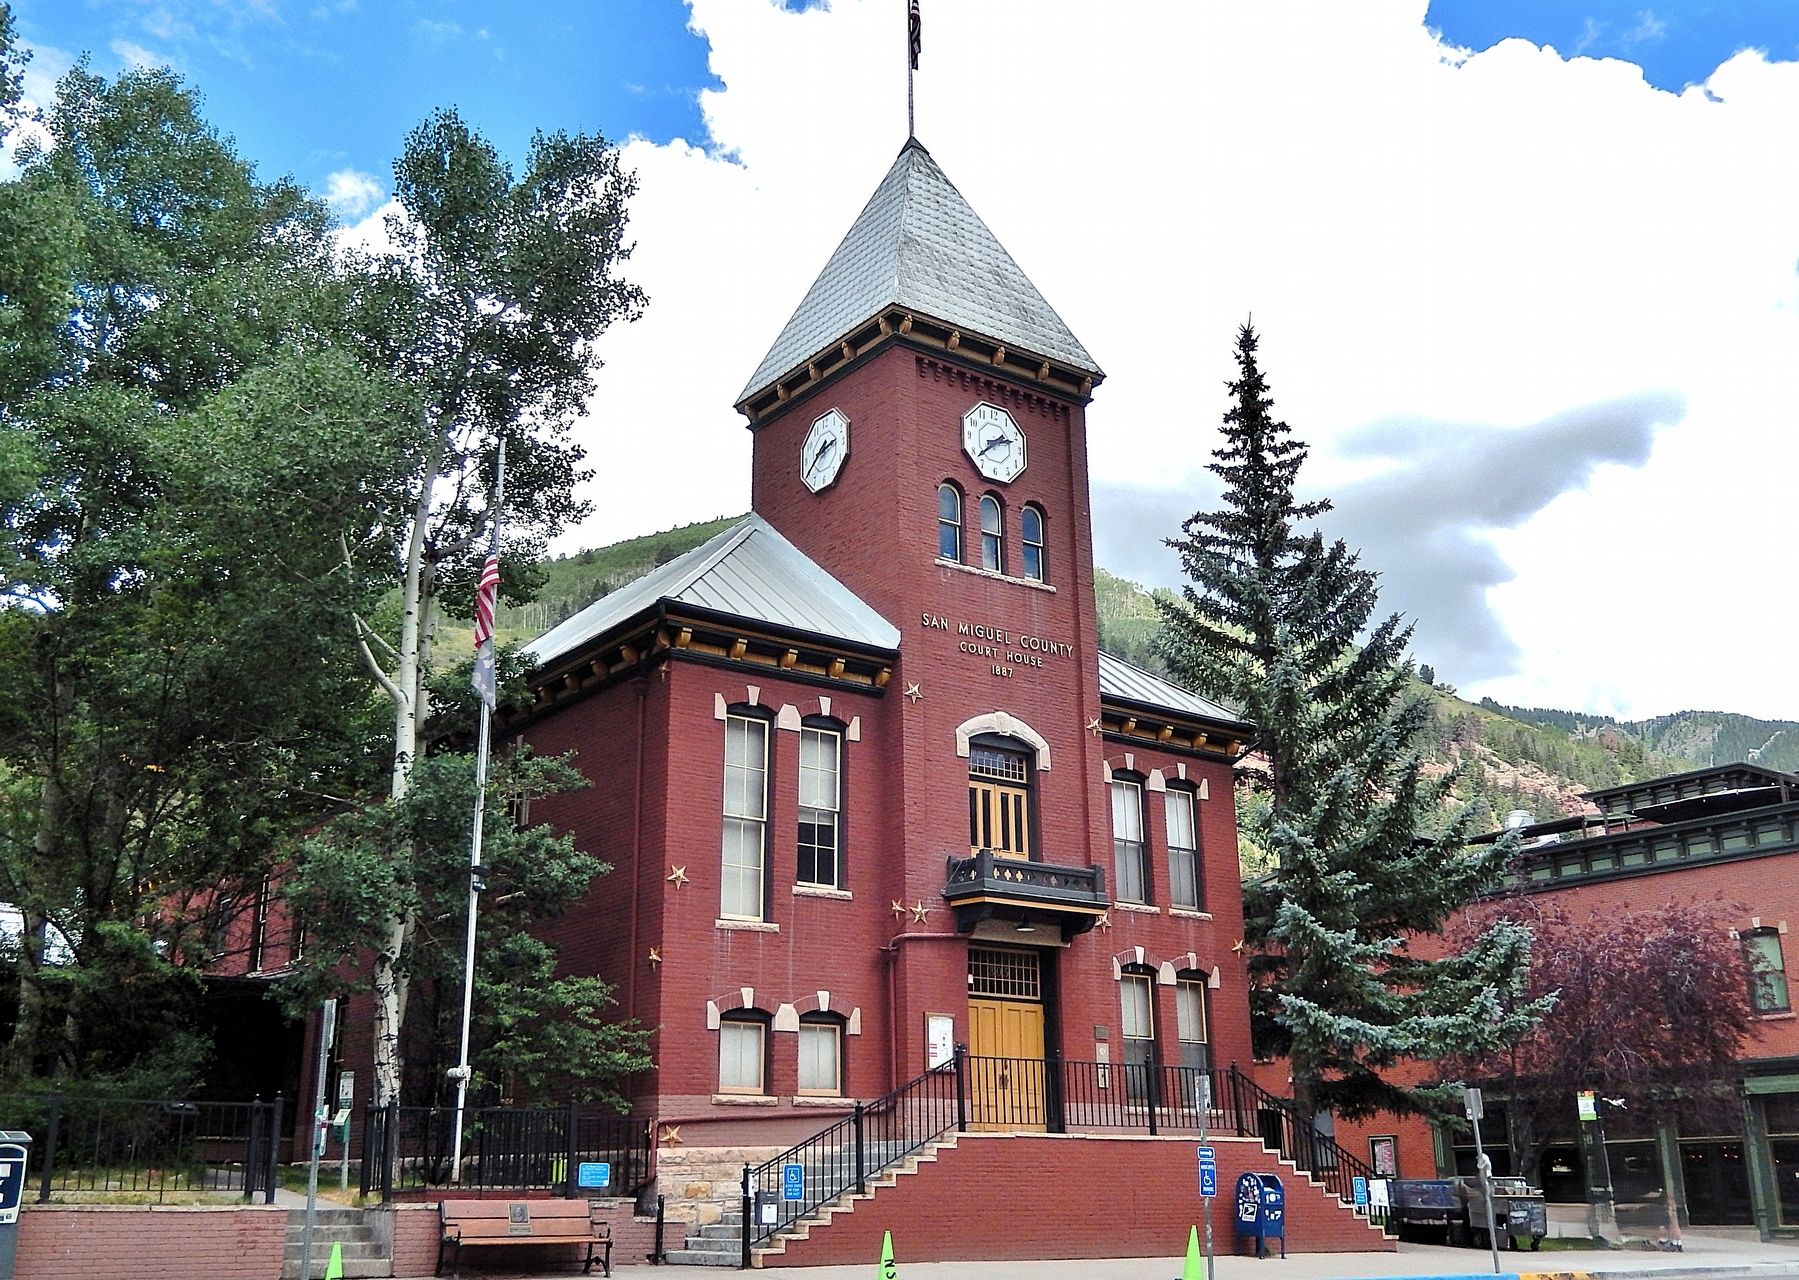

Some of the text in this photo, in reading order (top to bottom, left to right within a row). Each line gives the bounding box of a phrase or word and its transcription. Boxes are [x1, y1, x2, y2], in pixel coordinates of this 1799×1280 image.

[979, 409, 985, 420] 11
[990, 410, 998, 421] 12
[970, 417, 978, 428] 10
[1014, 431, 1018, 441] 2
[922, 612, 1073, 658] SAN MIGUEL COUNTY
[959, 641, 1043, 667] COURT HOUSE
[991, 664, 1014, 678] 1887
